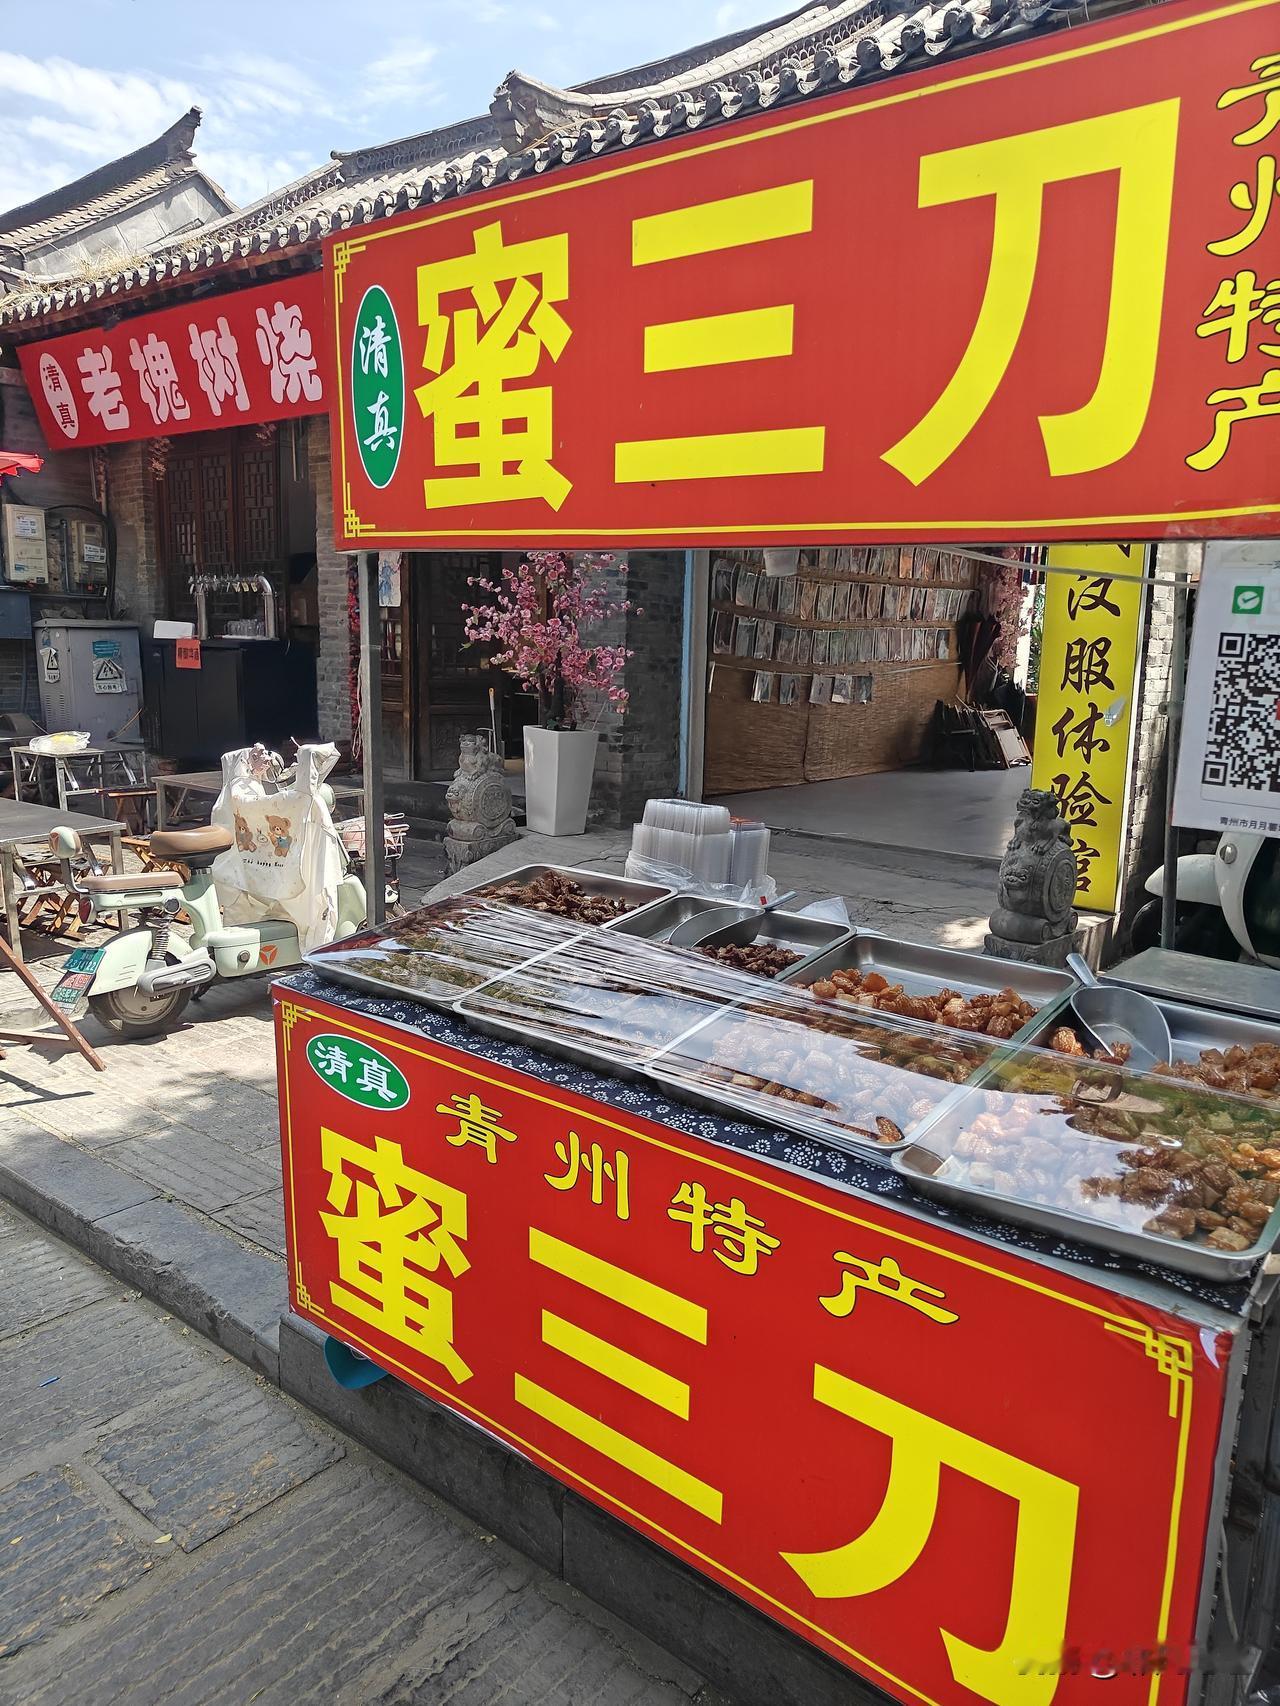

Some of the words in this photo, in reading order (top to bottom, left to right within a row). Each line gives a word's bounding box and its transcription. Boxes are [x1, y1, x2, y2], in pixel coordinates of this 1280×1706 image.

[43, 364, 76, 429] 清真
[77, 301, 323, 431] 老槐树烧
[359, 315, 398, 453] 清真
[414, 98, 1181, 511] 蜜三刀
[1051, 544, 1131, 893] 汉服体验馆
[314, 1041, 398, 1102] 清真
[435, 1093, 961, 1326] 青州特产
[318, 1127, 1079, 1706] 蜜三刀
